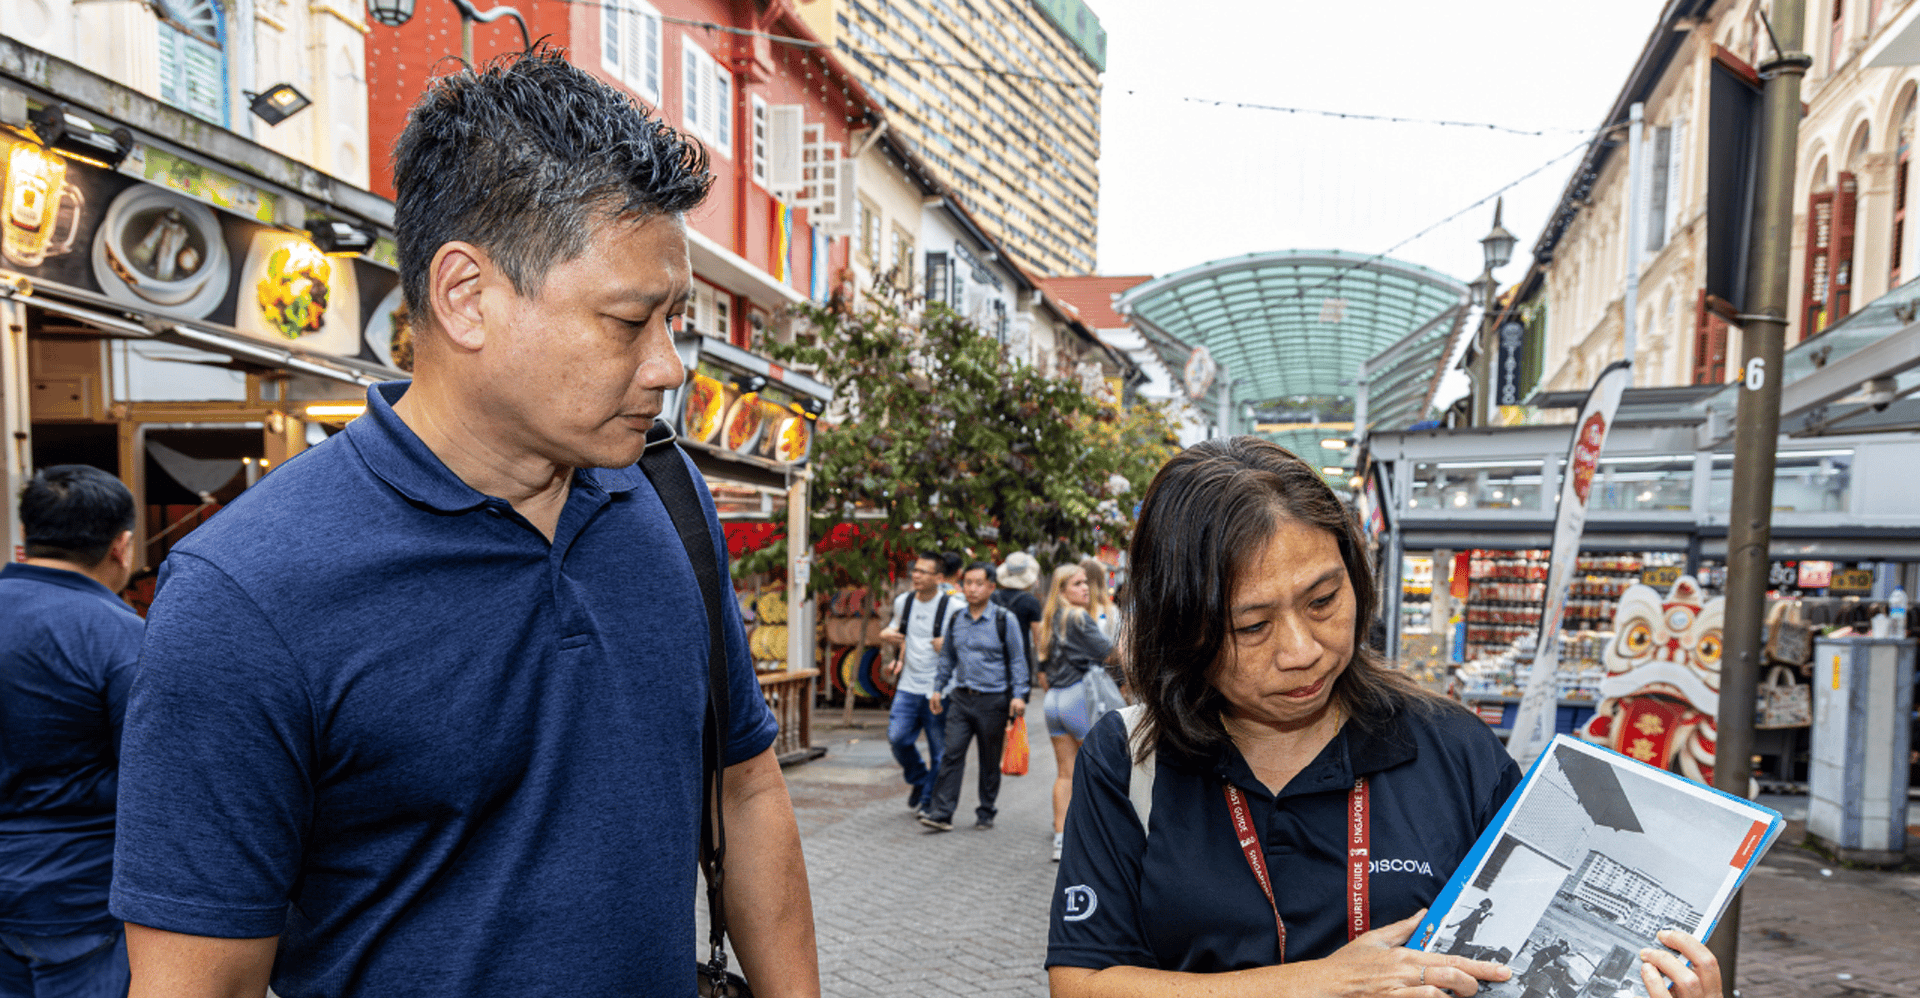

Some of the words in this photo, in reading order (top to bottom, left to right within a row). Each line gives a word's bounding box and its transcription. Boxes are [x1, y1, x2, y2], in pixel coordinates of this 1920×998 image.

[1746, 356, 1765, 391] 6
[1234, 806, 1249, 832] GUIDE
[1354, 794, 1363, 844] SINGAPORE
[1353, 861, 1363, 890] GUIDE
[1353, 892, 1363, 932] TOURIST
